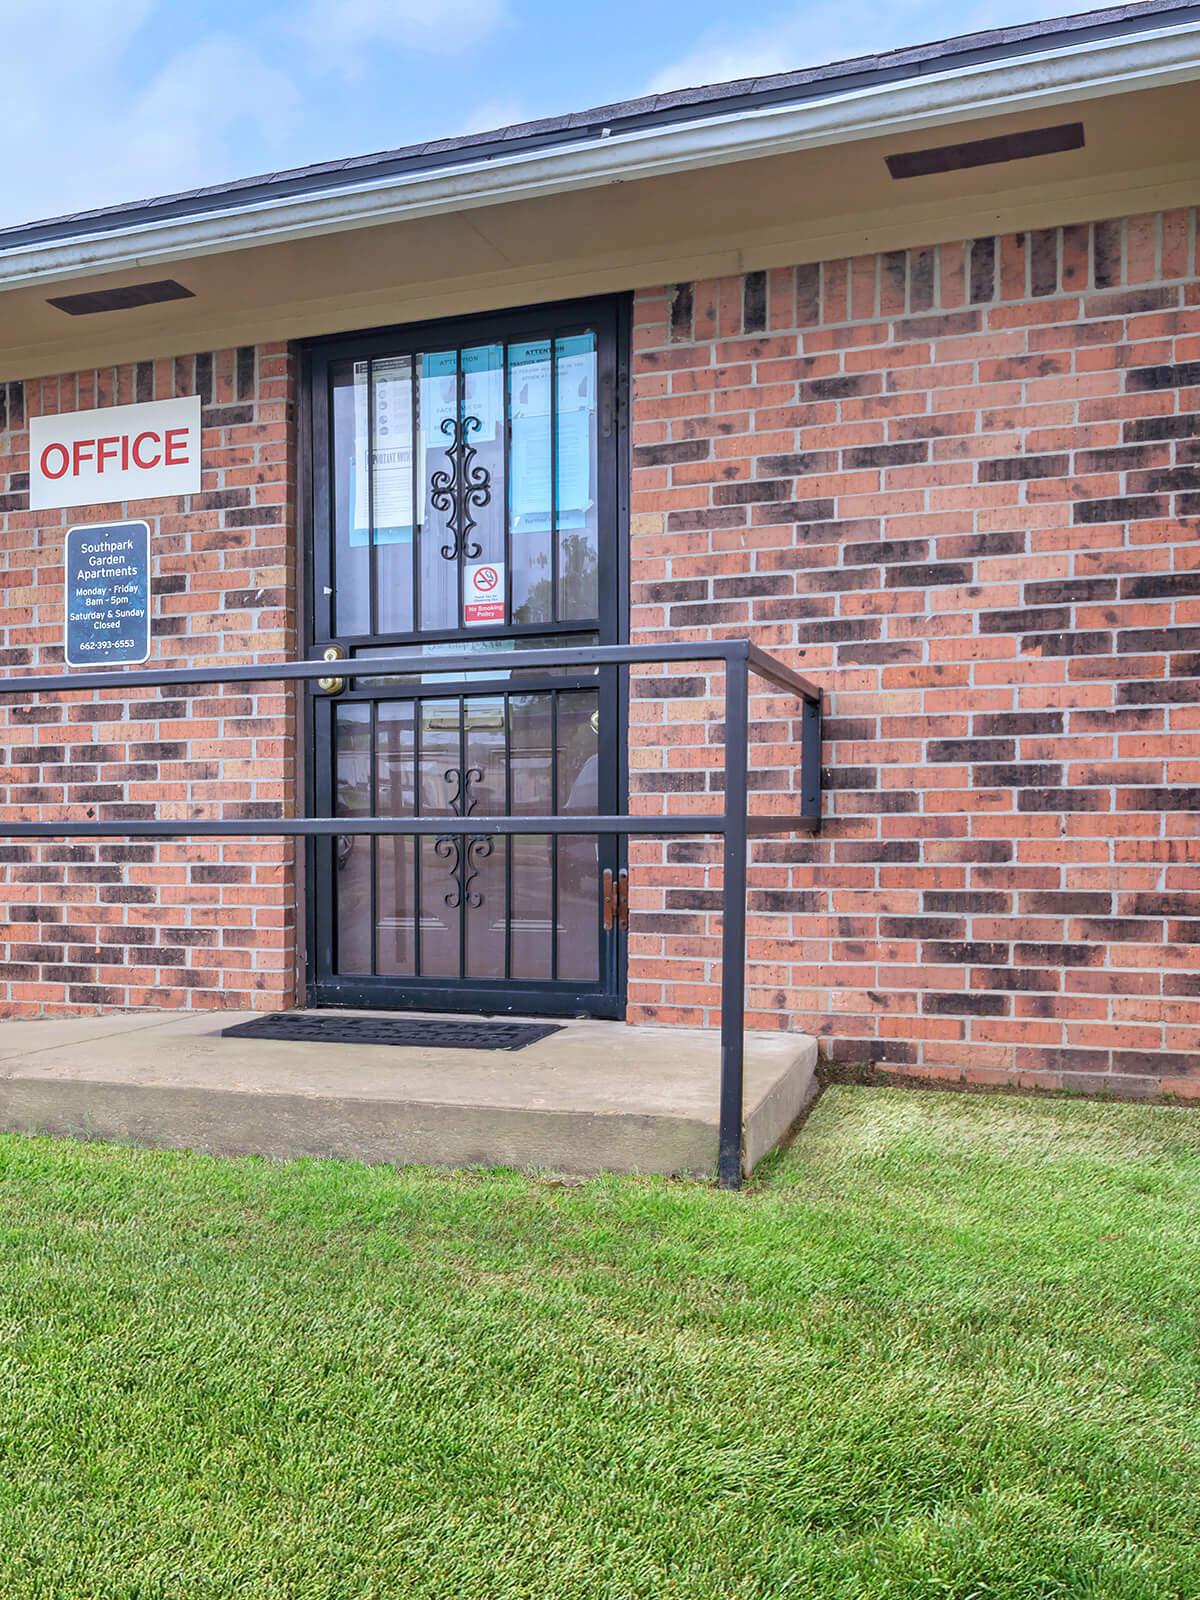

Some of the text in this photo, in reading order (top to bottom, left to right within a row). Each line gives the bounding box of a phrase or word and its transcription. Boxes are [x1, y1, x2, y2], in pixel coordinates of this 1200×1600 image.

[525, 345, 565, 356] ATTENON
[440, 355, 479, 366] ATTETION
[40, 428, 189, 480] OFFICE
[81, 539, 134, 554] Southpark
[88, 555, 125, 567] Garden
[77, 566, 138, 581] Apartments
[76, 587, 106, 597] Monday
[113, 584, 139, 595] Friday
[85, 598, 104, 606] 8am
[110, 596, 129, 605] 5pm
[70, 608, 145, 621] Saturday & Sunday
[93, 620, 121, 630] Closed
[80, 639, 135, 650] 662-393-6553
